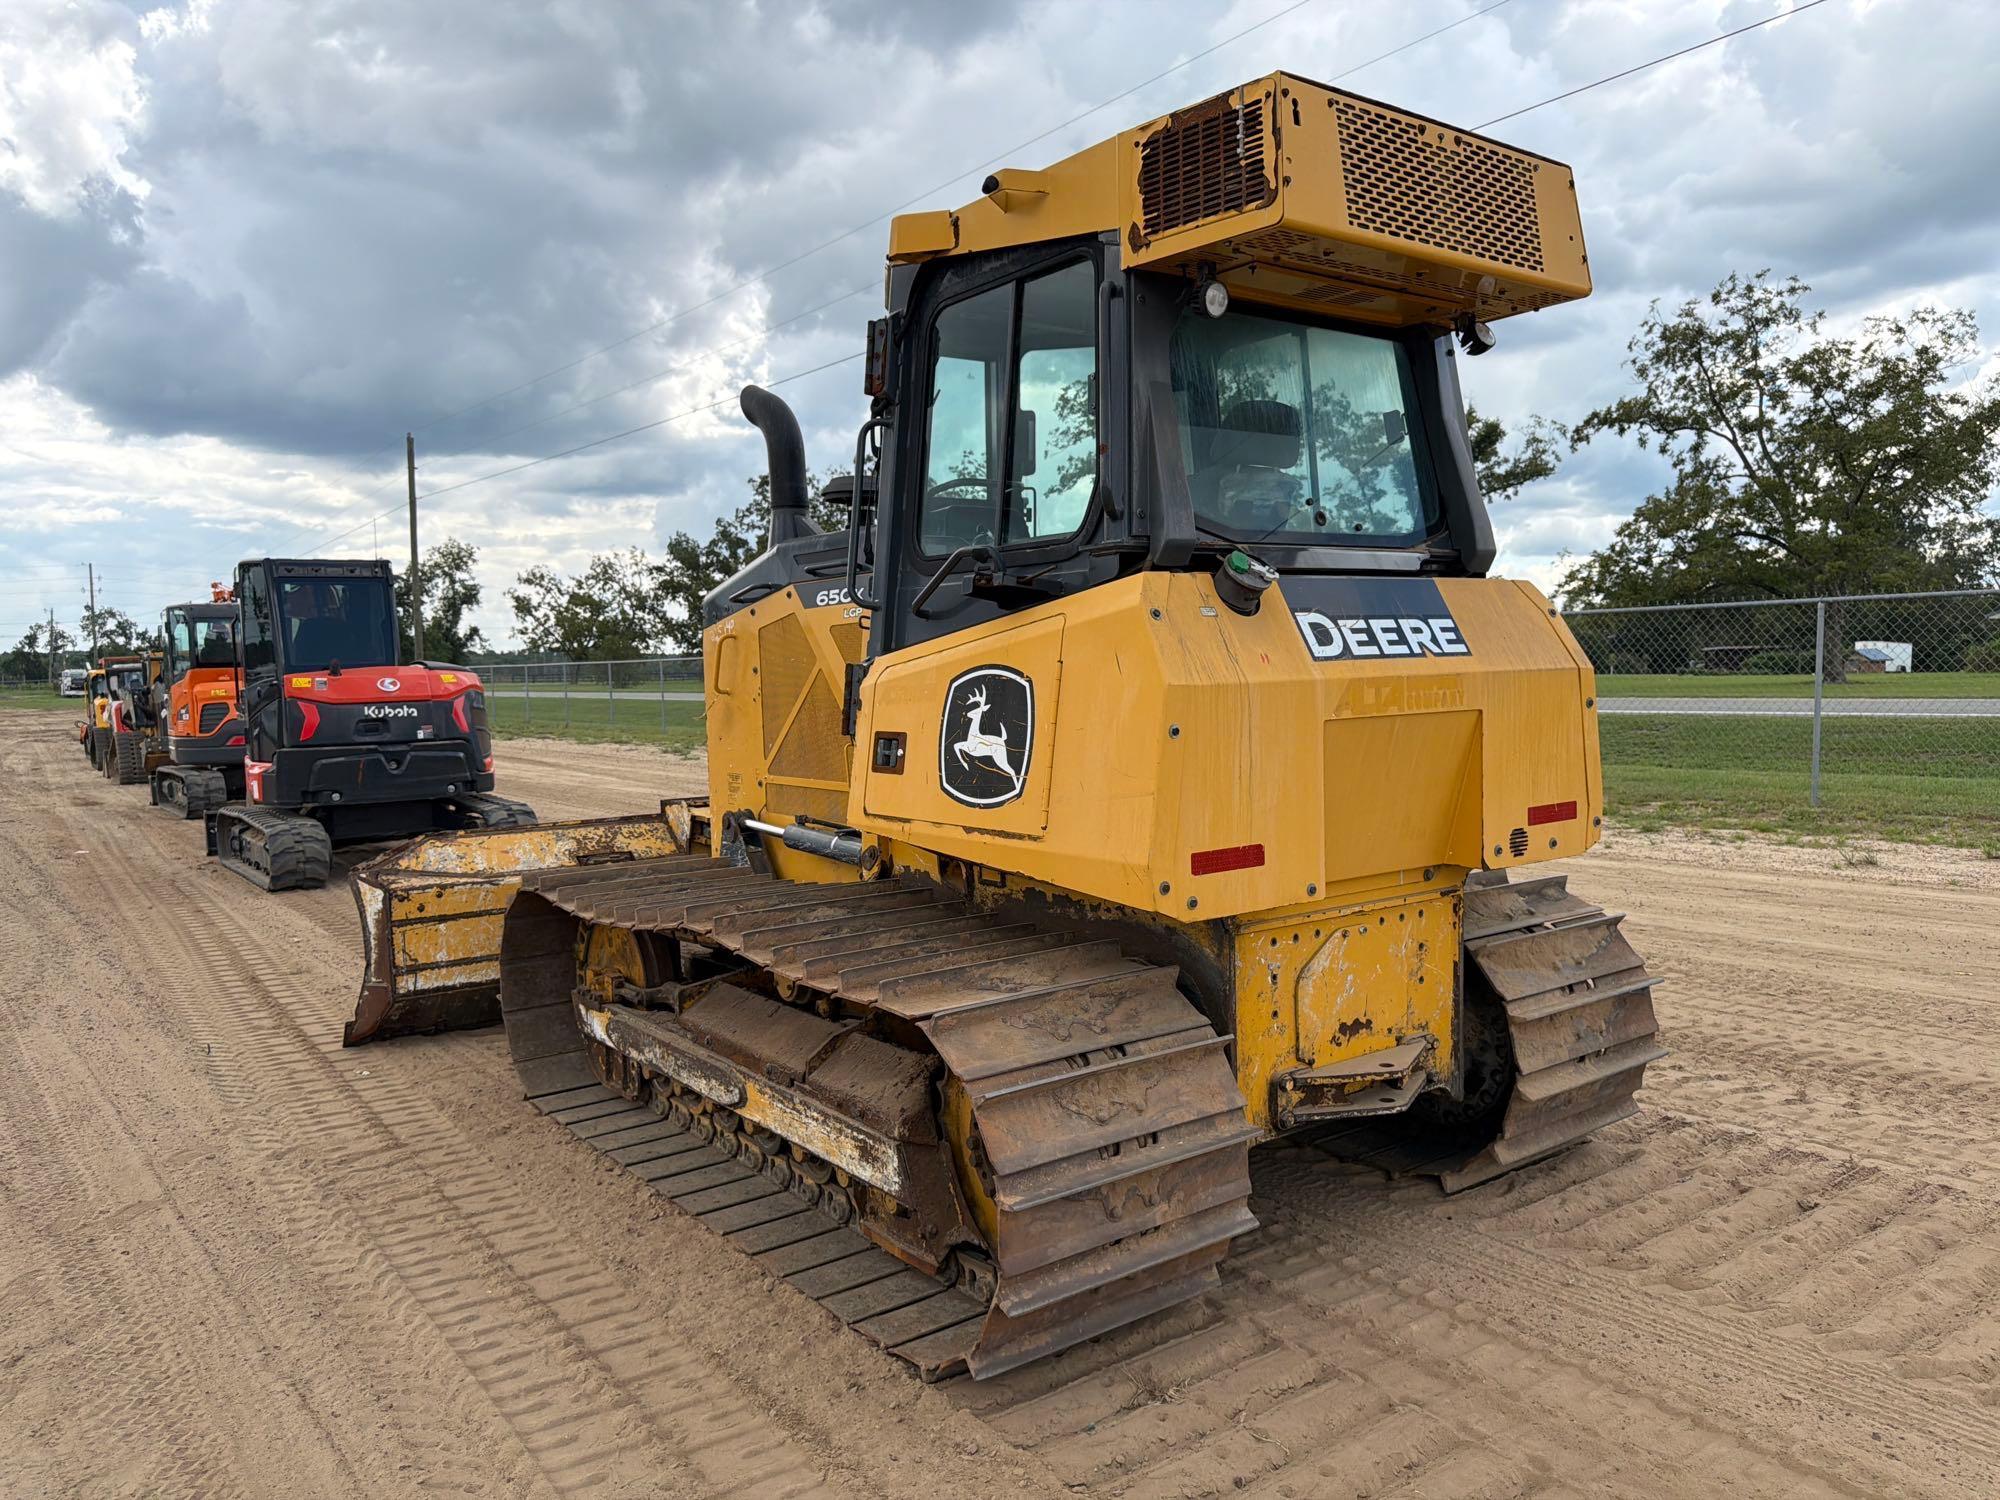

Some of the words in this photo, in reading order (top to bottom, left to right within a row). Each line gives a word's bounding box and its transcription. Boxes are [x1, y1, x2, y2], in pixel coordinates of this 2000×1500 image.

[843, 607, 863, 618] LGP
[1294, 612, 1468, 657] DEERE
[364, 705, 418, 718] Kubota
